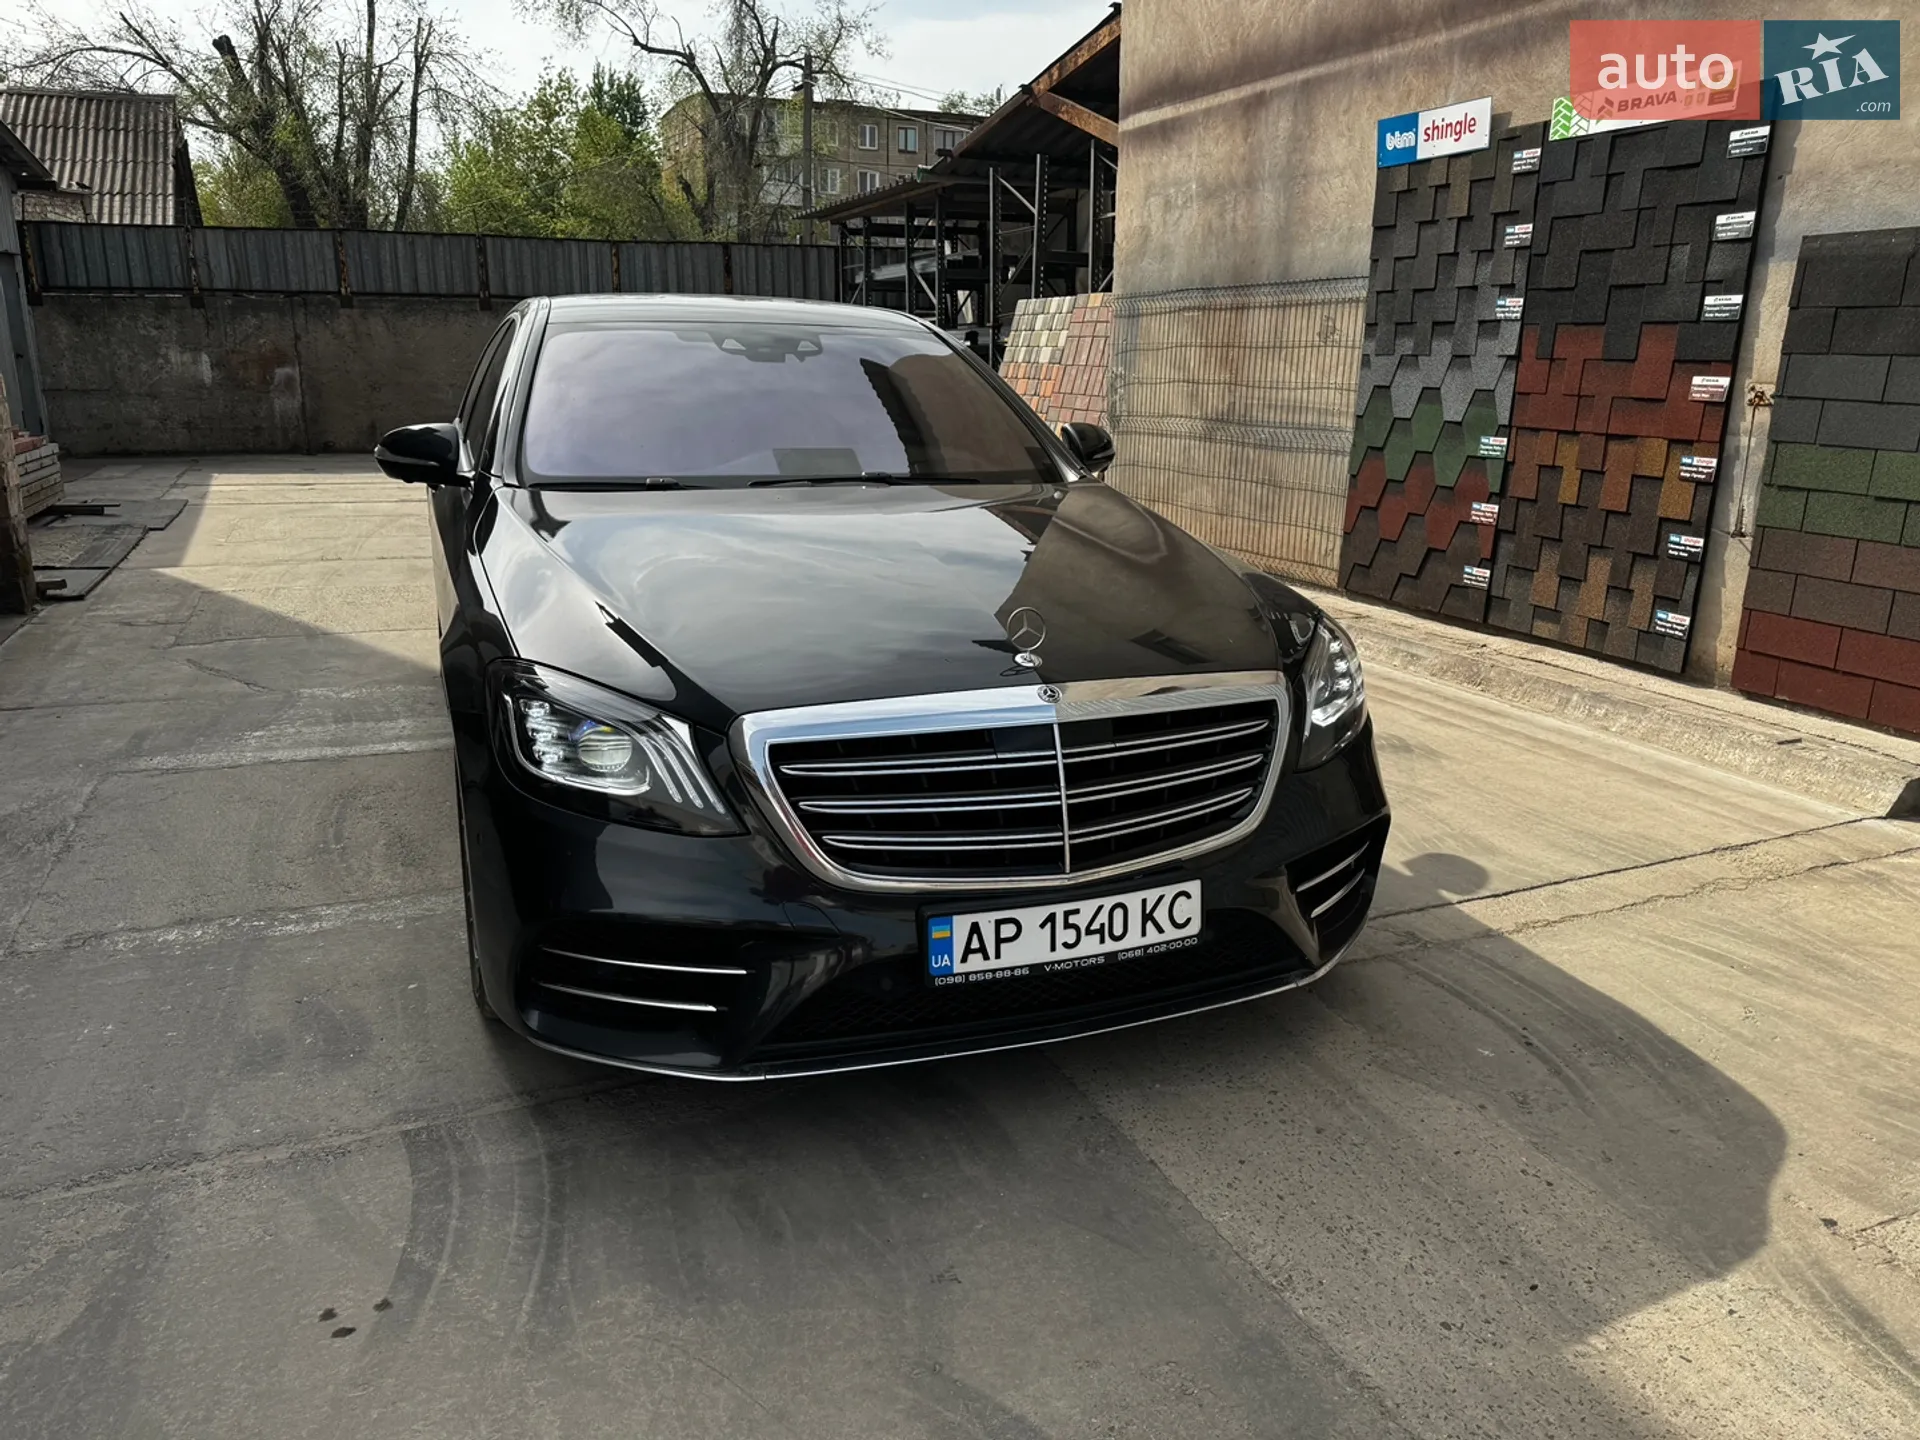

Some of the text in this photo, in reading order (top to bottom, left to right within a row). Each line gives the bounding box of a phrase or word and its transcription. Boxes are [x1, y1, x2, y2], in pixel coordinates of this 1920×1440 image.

[1617, 90, 1678, 112] BRAVA
[1423, 112, 1477, 142] shingle
[960, 890, 1193, 964] AP 1540 KC
[932, 954, 951, 969] UA
[1044, 956, 1106, 972] V-MOTORS
